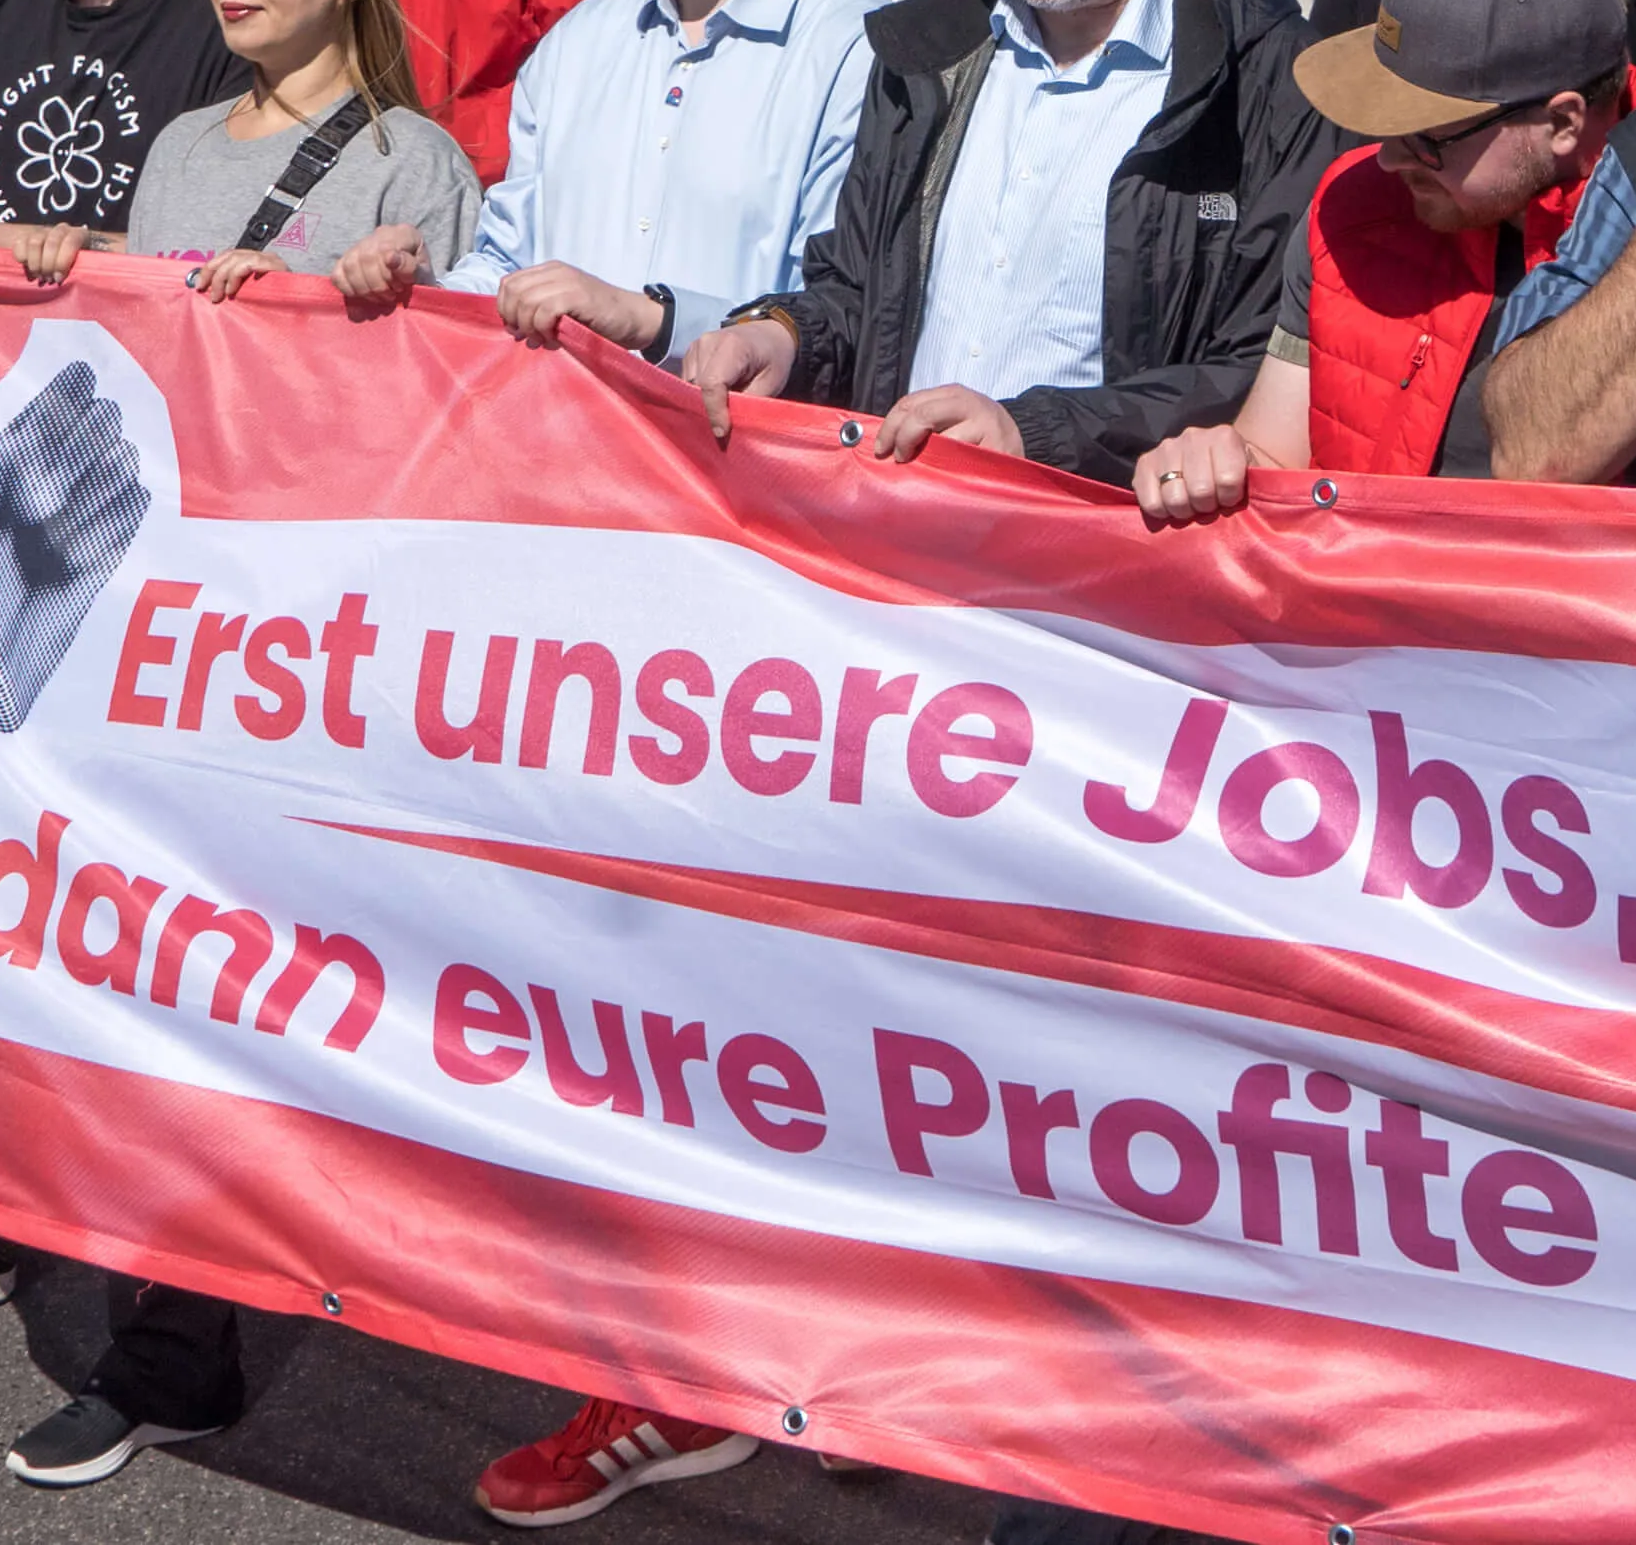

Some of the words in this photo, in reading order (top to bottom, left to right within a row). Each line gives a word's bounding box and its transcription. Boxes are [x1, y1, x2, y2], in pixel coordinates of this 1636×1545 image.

[107, 579, 379, 749] Erst
[414, 630, 1035, 819] unsere
[432, 962, 828, 1154] eure
[872, 1027, 1600, 1288] Profite
